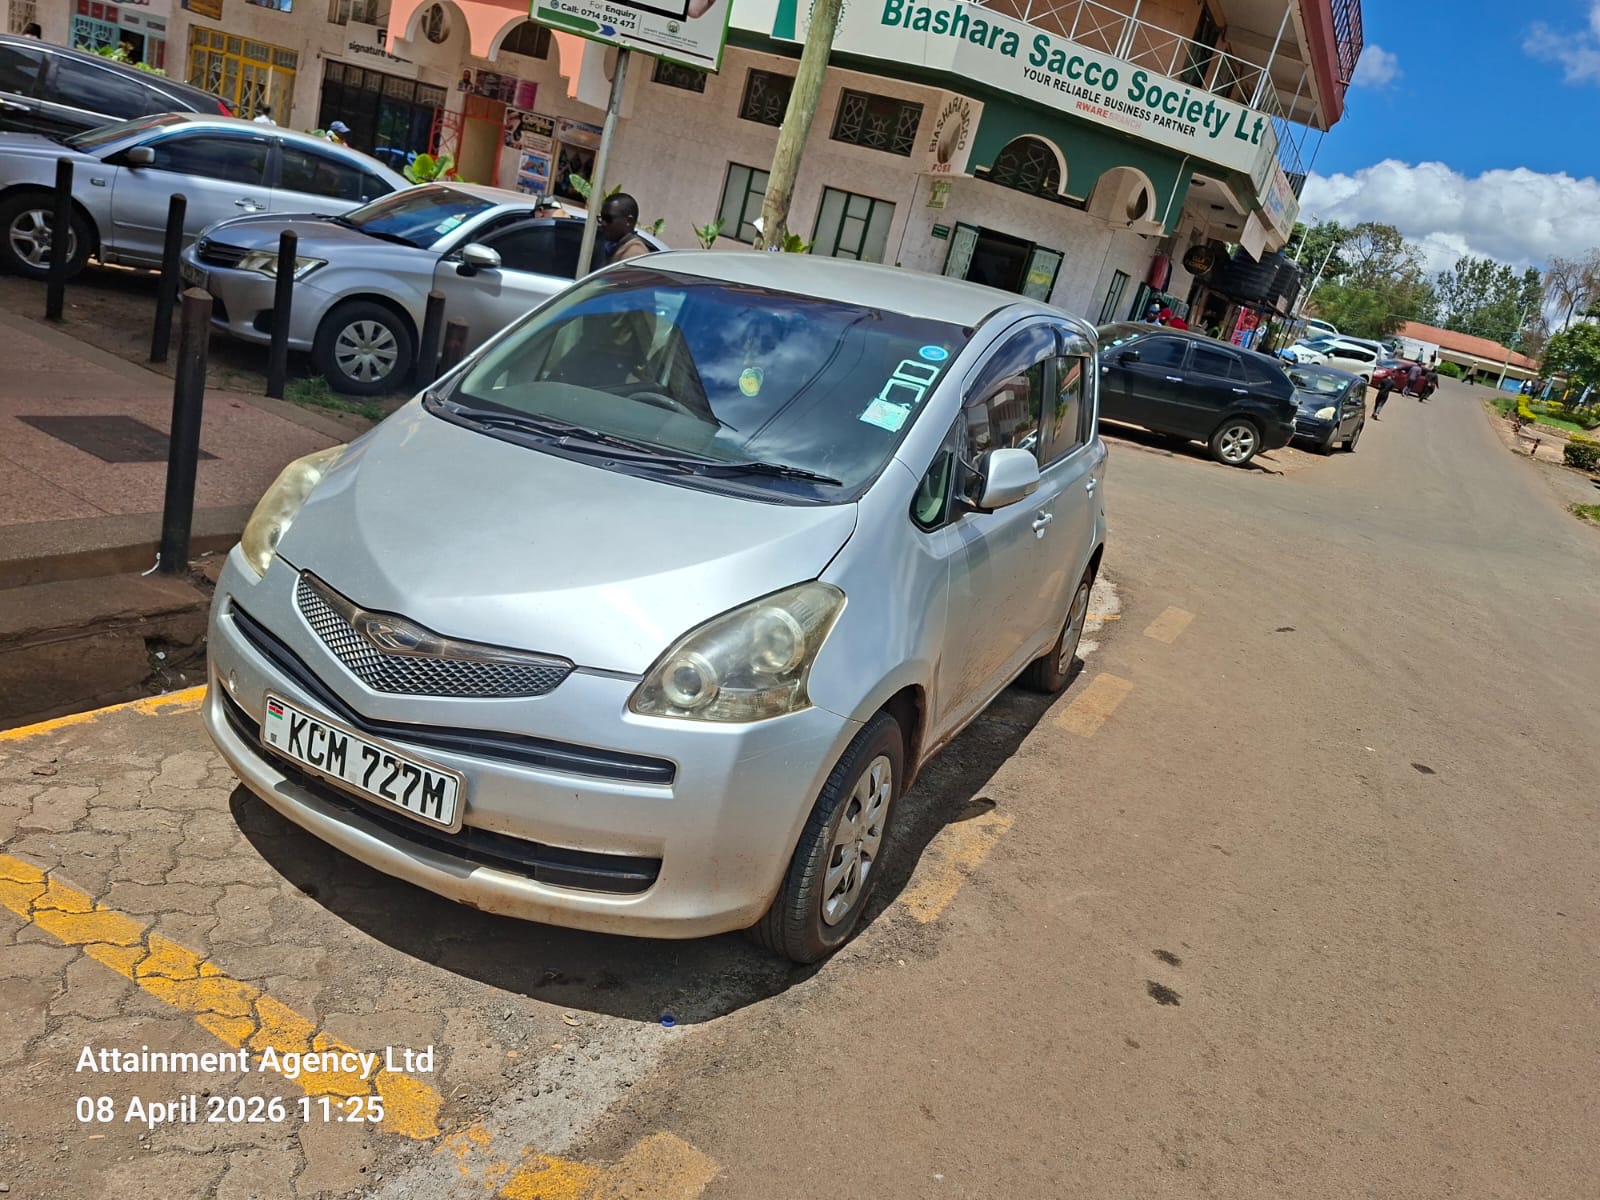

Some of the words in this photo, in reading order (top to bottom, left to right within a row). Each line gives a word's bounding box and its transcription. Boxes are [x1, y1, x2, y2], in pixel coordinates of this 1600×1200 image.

[581, 8, 601, 19] 0714
[602, 14, 618, 25] 952
[619, 19, 636, 29] 473
[590, 0, 604, 9] For
[605, 4, 638, 20] Enquiry
[348, 40, 386, 57] signature
[881, 0, 1020, 58] Biashara
[1028, 34, 1119, 91] Sacco
[1127, 70, 1231, 139] Society
[1023, 66, 1052, 87] YOUR
[1052, 78, 1102, 104] RELIABLE
[1103, 96, 1152, 121] BUSINESS
[1153, 113, 1197, 137] PARTNER
[1075, 101, 1109, 119] RWARE
[288, 712, 348, 778] KCM
[361, 745, 446, 820] 727M
